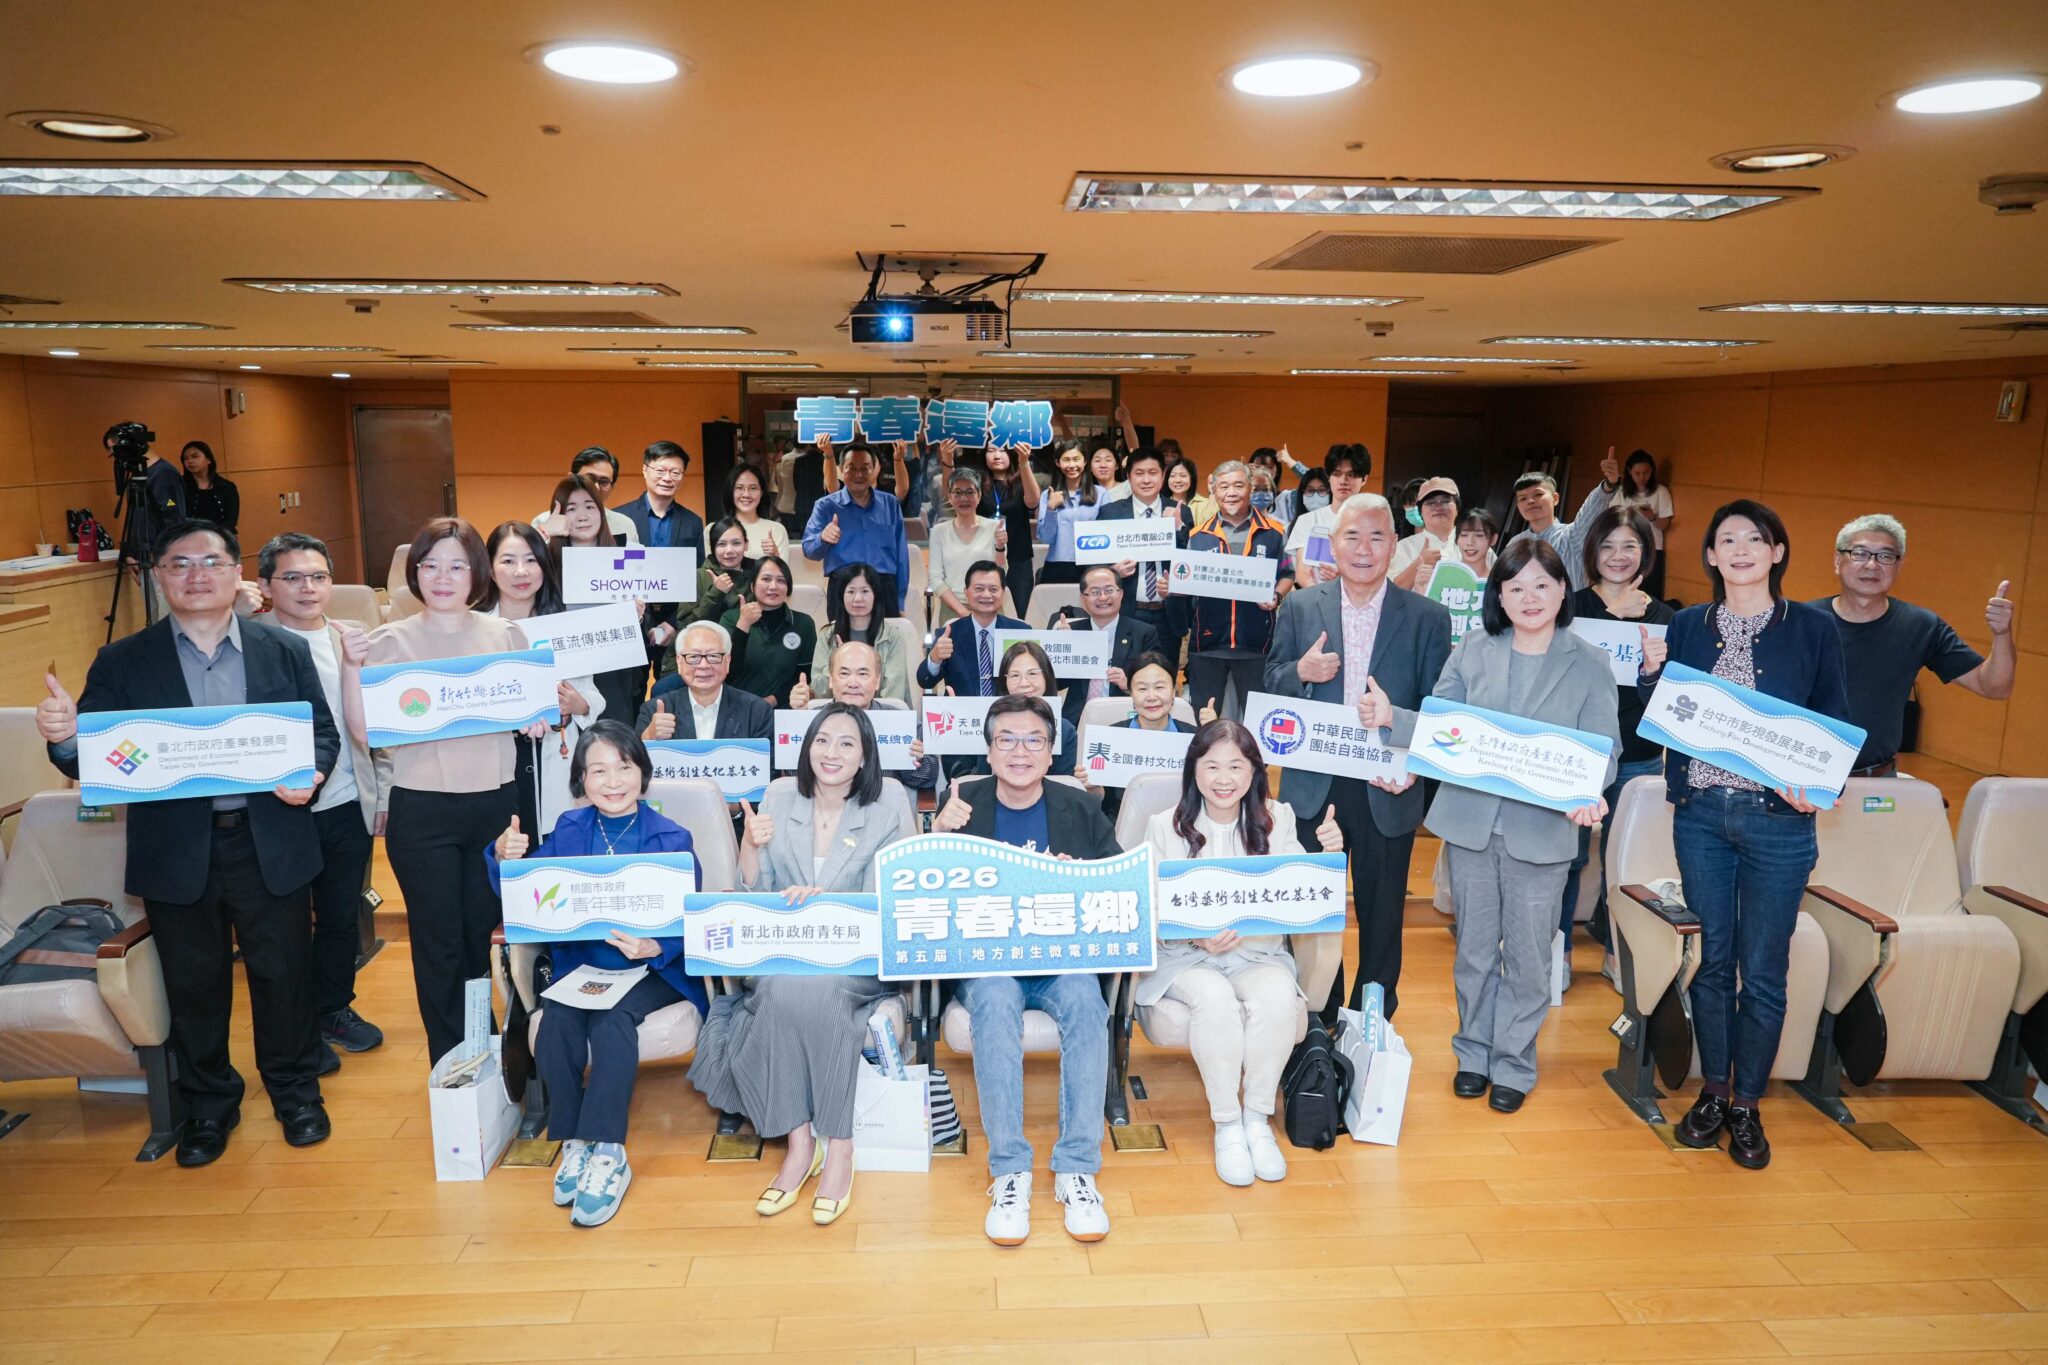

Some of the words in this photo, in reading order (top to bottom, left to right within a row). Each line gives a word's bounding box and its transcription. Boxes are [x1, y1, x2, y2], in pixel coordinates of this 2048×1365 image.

[794, 397, 1053, 449] 青春還鄉
[1081, 536, 1106, 548] TCA
[1116, 532, 1174, 543] 台北市電腦公會
[590, 579, 668, 591] SHOWTIME
[552, 625, 637, 651] 匯流傳媒集團
[1044, 643, 1072, 653] 救國團
[439, 679, 522, 703] 新竹縣政府
[1312, 722, 1369, 743] 中華民國
[1701, 706, 1833, 766] 台中市影視發展基金會
[156, 734, 288, 754] 臺北市政府產業發展局
[1310, 738, 1394, 763] 團結自強協會
[1787, 753, 1826, 775] Foundation
[570, 881, 626, 894] 桃園市政府
[892, 866, 999, 891] 2026
[571, 895, 664, 914] 青年事務局
[893, 890, 1140, 942] 青春還鄉
[741, 925, 861, 939] 新北市政府青年局
[895, 949, 947, 963] 第五屆
[972, 942, 1139, 961] 地方創生微電影競賽
